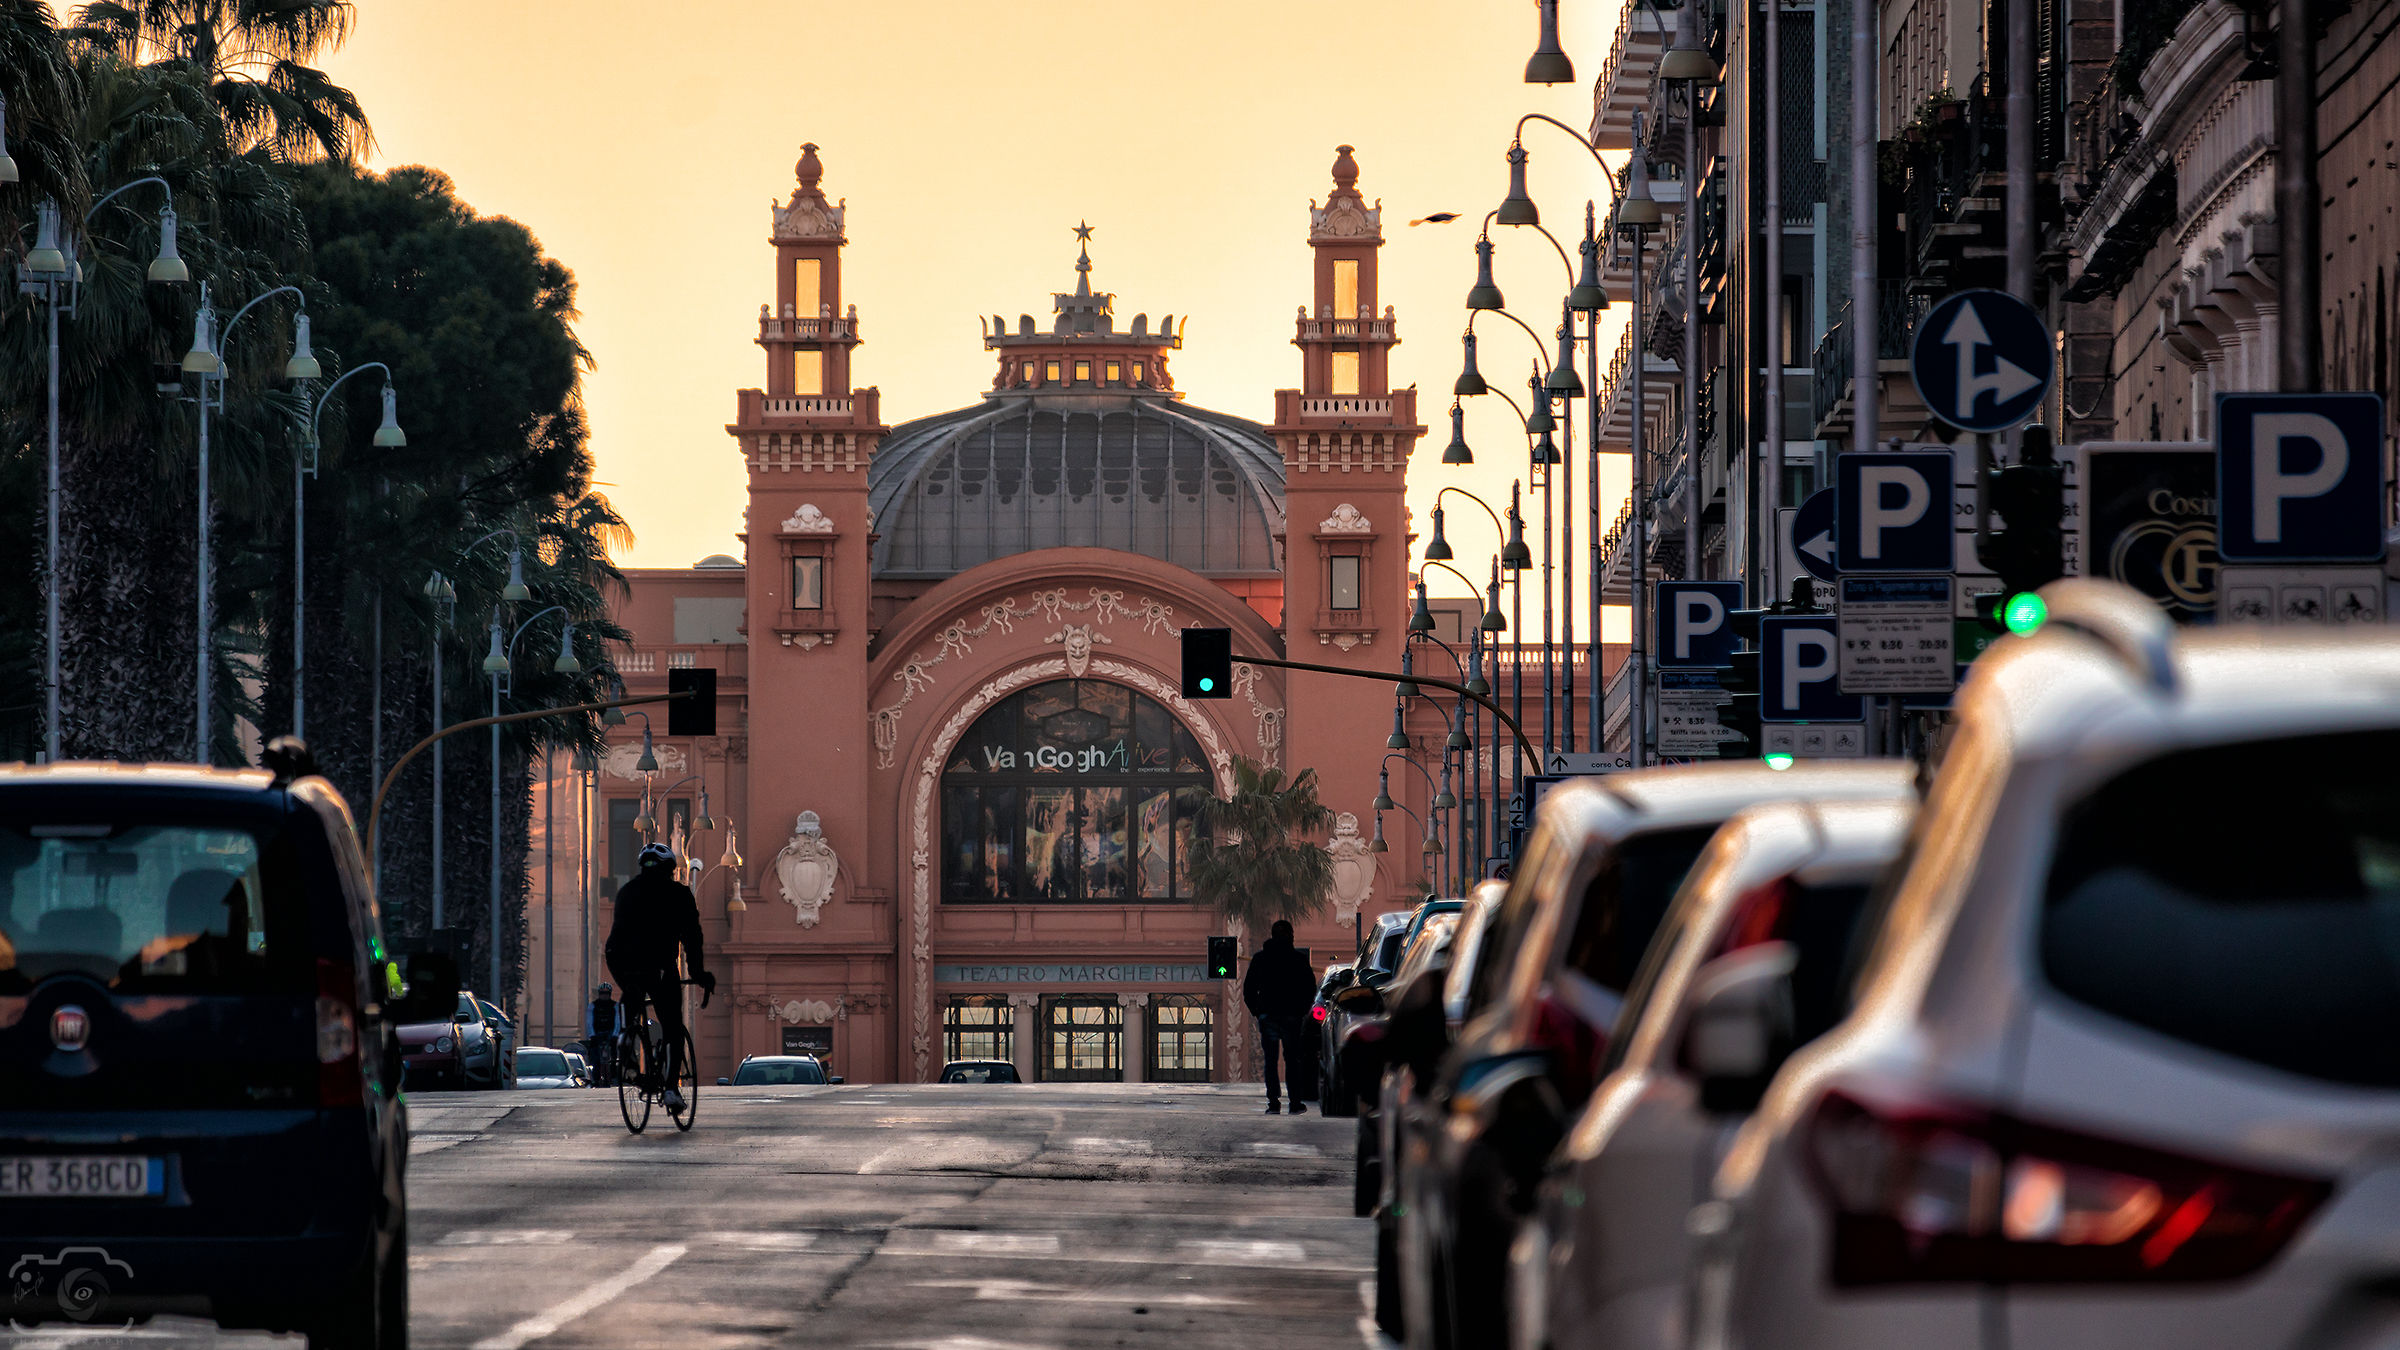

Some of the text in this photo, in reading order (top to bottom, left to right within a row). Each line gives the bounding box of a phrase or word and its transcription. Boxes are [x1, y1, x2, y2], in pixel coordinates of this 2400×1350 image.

[1860, 465, 1930, 559] P
[2253, 413, 2350, 543] P
[1675, 591, 1725, 659] P
[1783, 628, 1837, 711] P
[1615, 758, 1657, 769] Caur
[959, 966, 1203, 982] TEATRO MARGHERITA
[48, 1162, 142, 1192] 368CD
